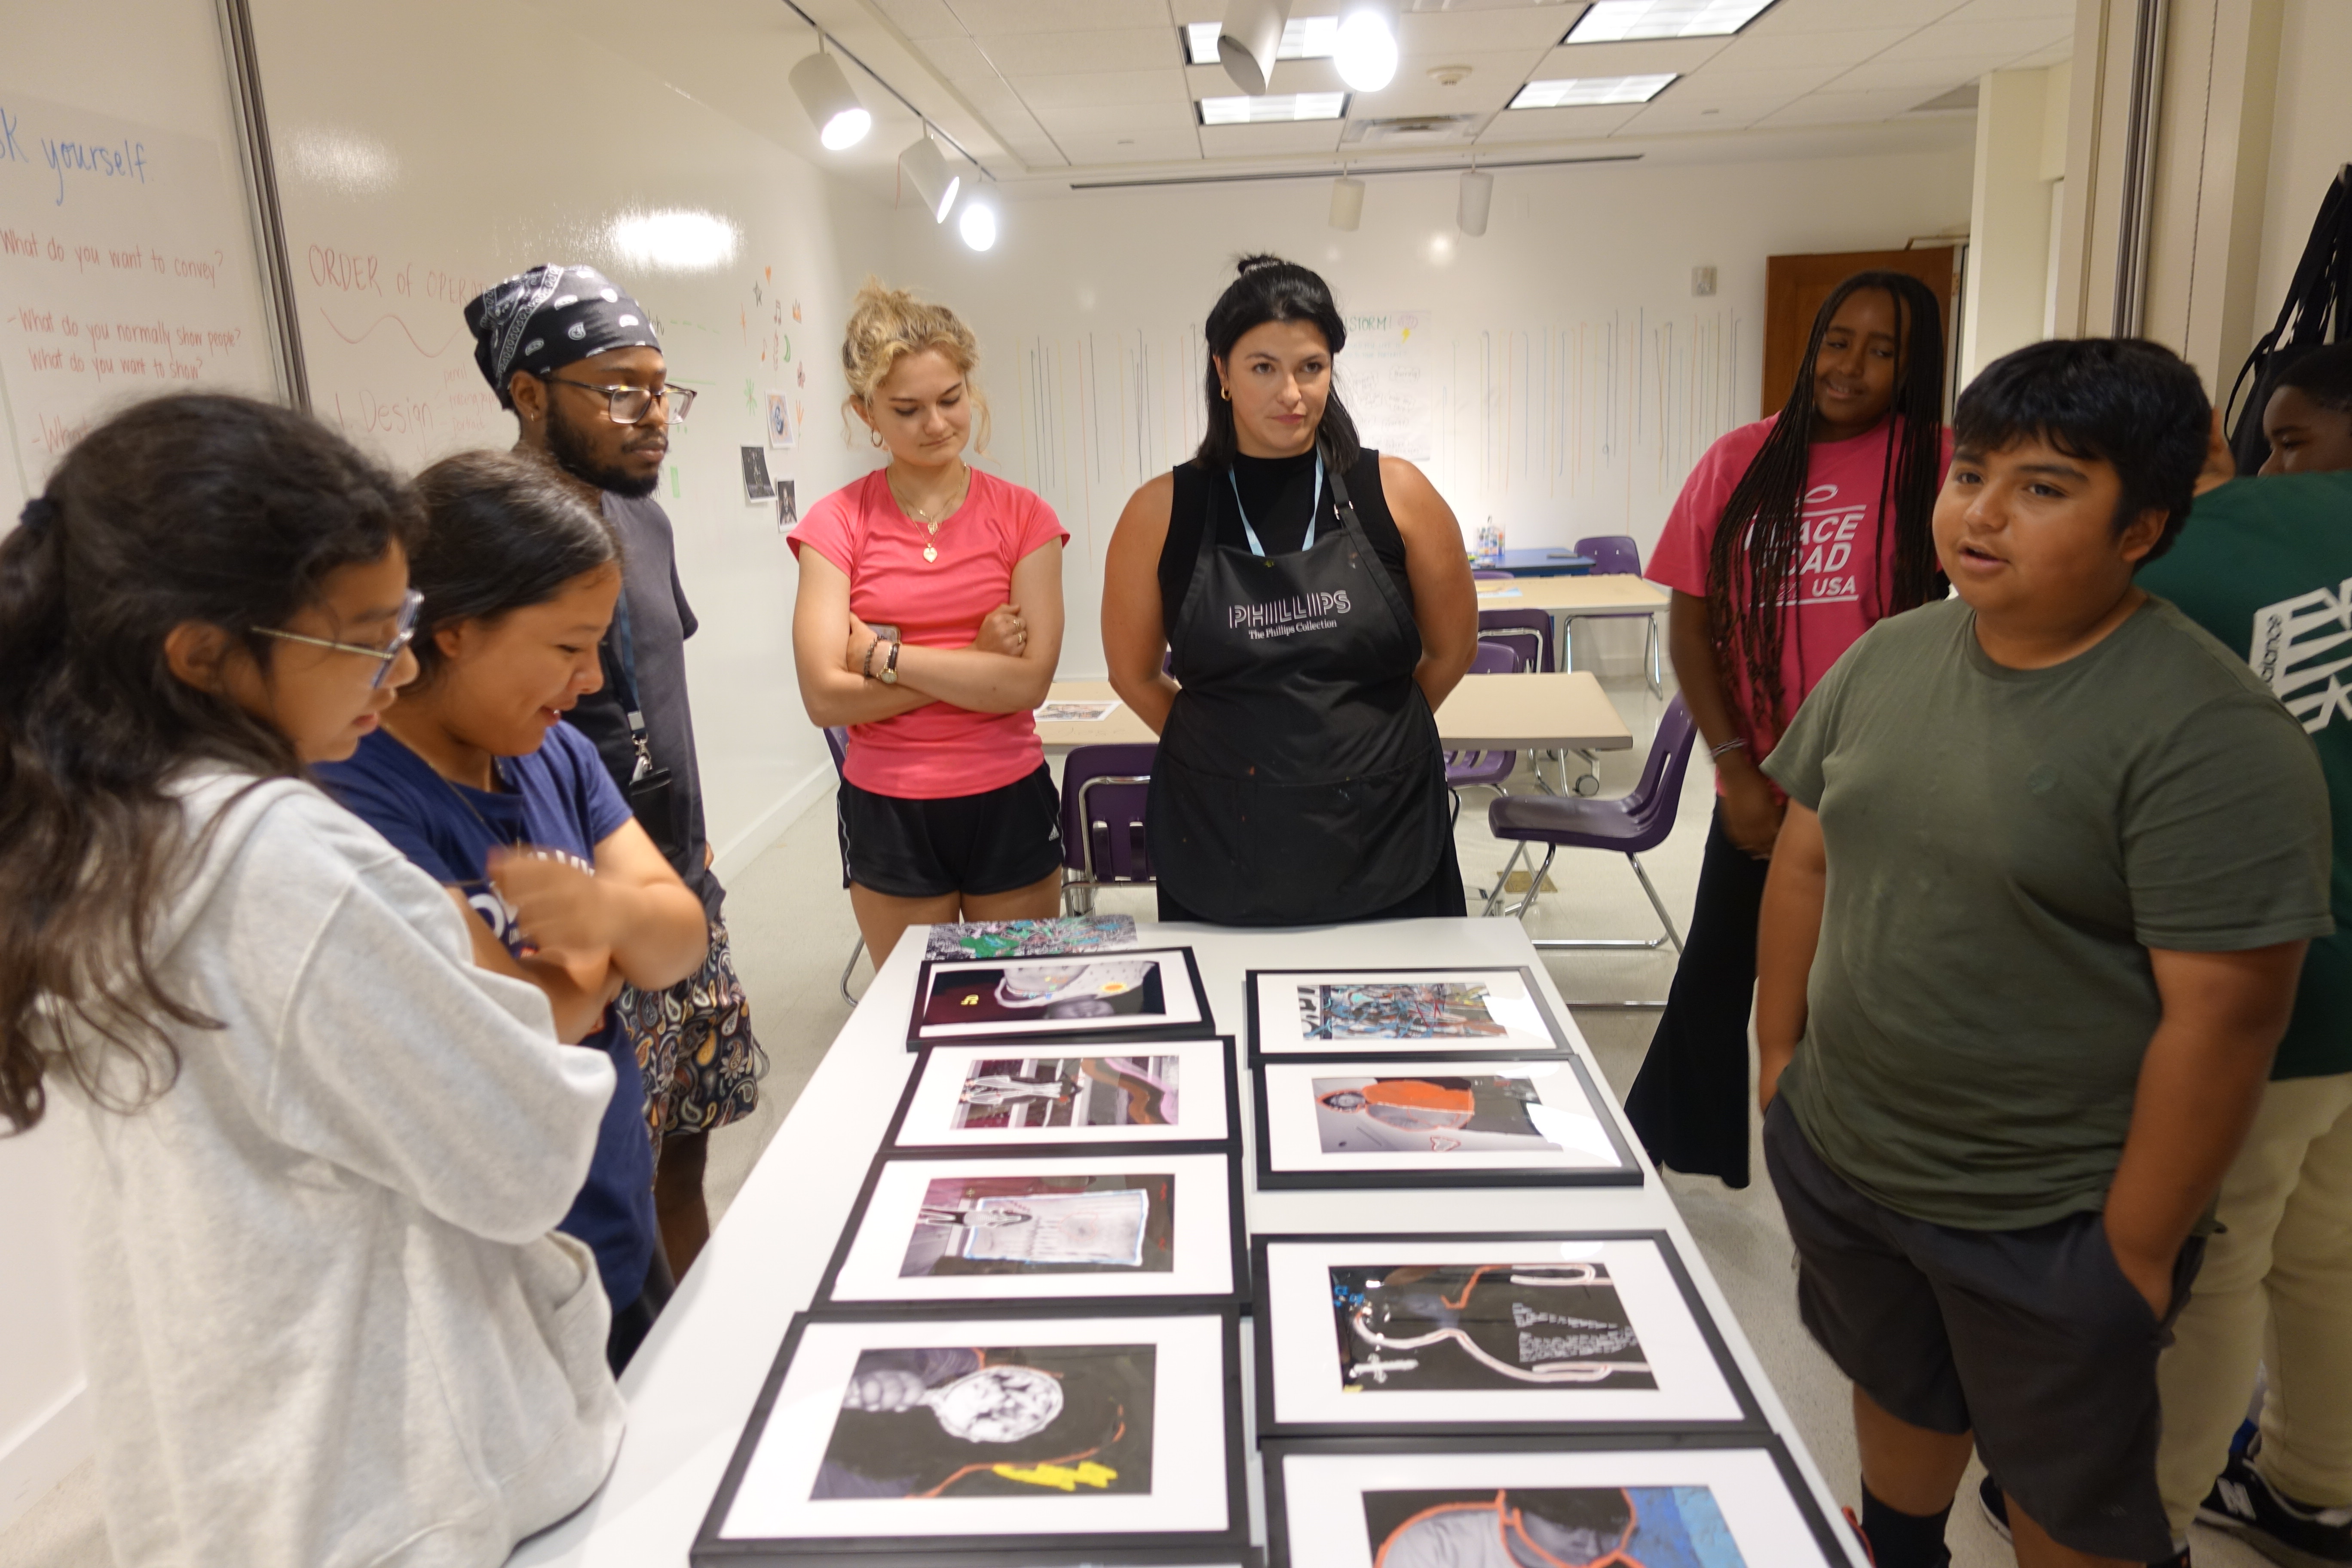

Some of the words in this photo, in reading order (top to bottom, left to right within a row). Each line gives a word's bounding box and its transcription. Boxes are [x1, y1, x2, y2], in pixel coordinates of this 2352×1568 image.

[41, 137, 147, 206] yourself
[1, 229, 38, 257] What
[48, 237, 64, 262] do
[75, 246, 99, 274] you
[109, 245, 142, 269] want
[151, 248, 165, 274] to
[174, 250, 223, 288] convey?
[309, 243, 382, 297] ORDER
[397, 263, 412, 297] of
[61, 315, 78, 337] do
[86, 323, 110, 352] you
[116, 321, 173, 358] normally
[177, 326, 202, 346] show
[208, 328, 241, 357] people?
[1345, 315, 1392, 331] STORM!
[28, 348, 63, 372] What
[70, 353, 84, 372] do
[92, 356, 114, 383] you
[120, 357, 146, 375] want
[153, 358, 165, 379] to
[171, 358, 202, 380] show?
[359, 389, 433, 459] Design
[1812, 575, 1856, 597] USA
[1229, 590, 1351, 629] PHILLIPS
[1249, 629, 1265, 640] The
[1266, 625, 1295, 638] Phillips
[1295, 618, 1337, 633] Collection
[2259, 613, 2282, 687] alance
